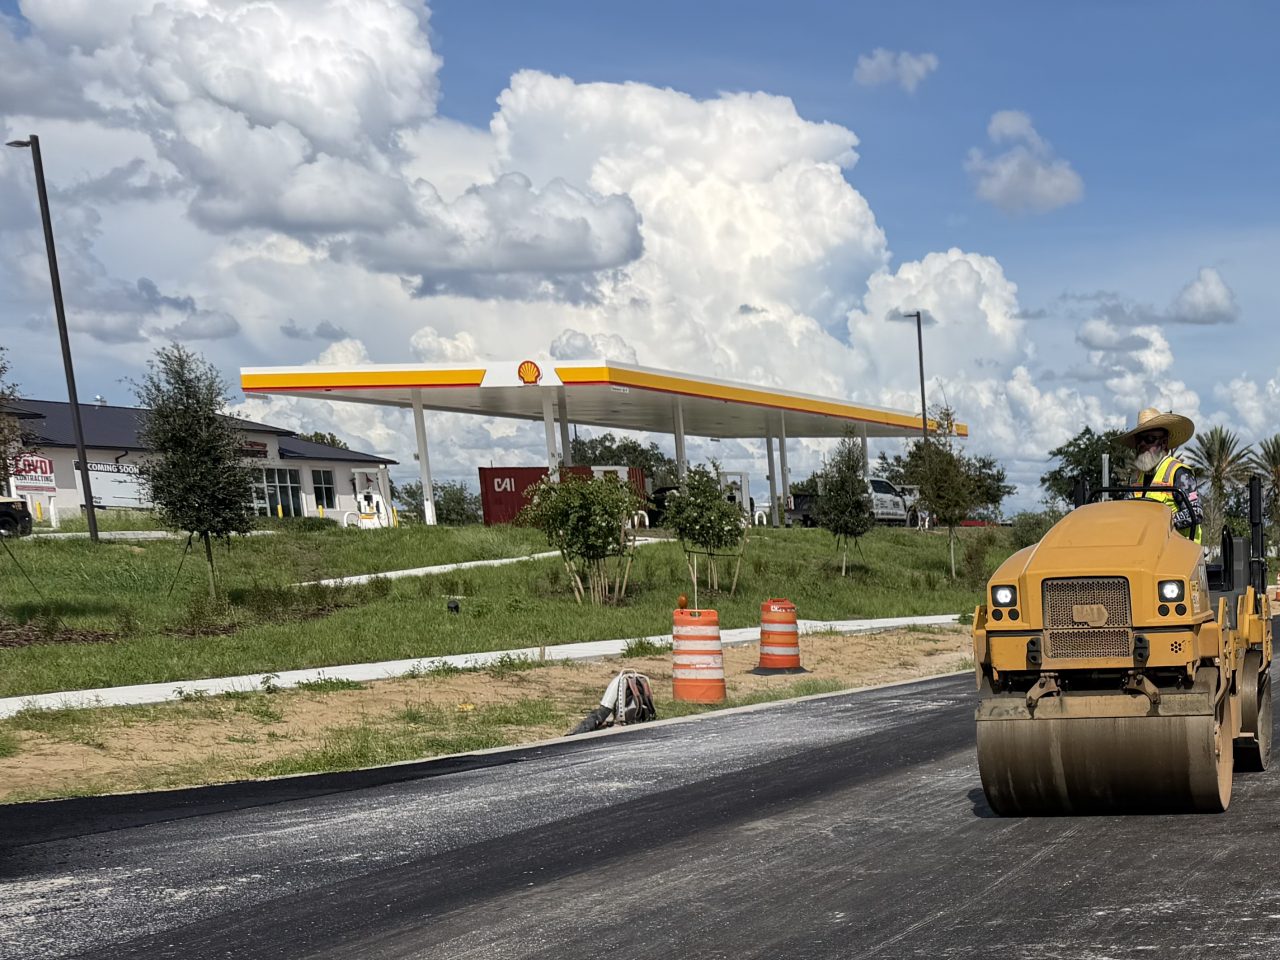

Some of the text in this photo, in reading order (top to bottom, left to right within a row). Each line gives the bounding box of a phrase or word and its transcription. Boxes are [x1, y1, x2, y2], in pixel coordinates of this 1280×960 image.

[87, 463, 140, 474] COMING SOON
[15, 474, 54, 483] CONTRACTING
[494, 478, 515, 492] CAI
